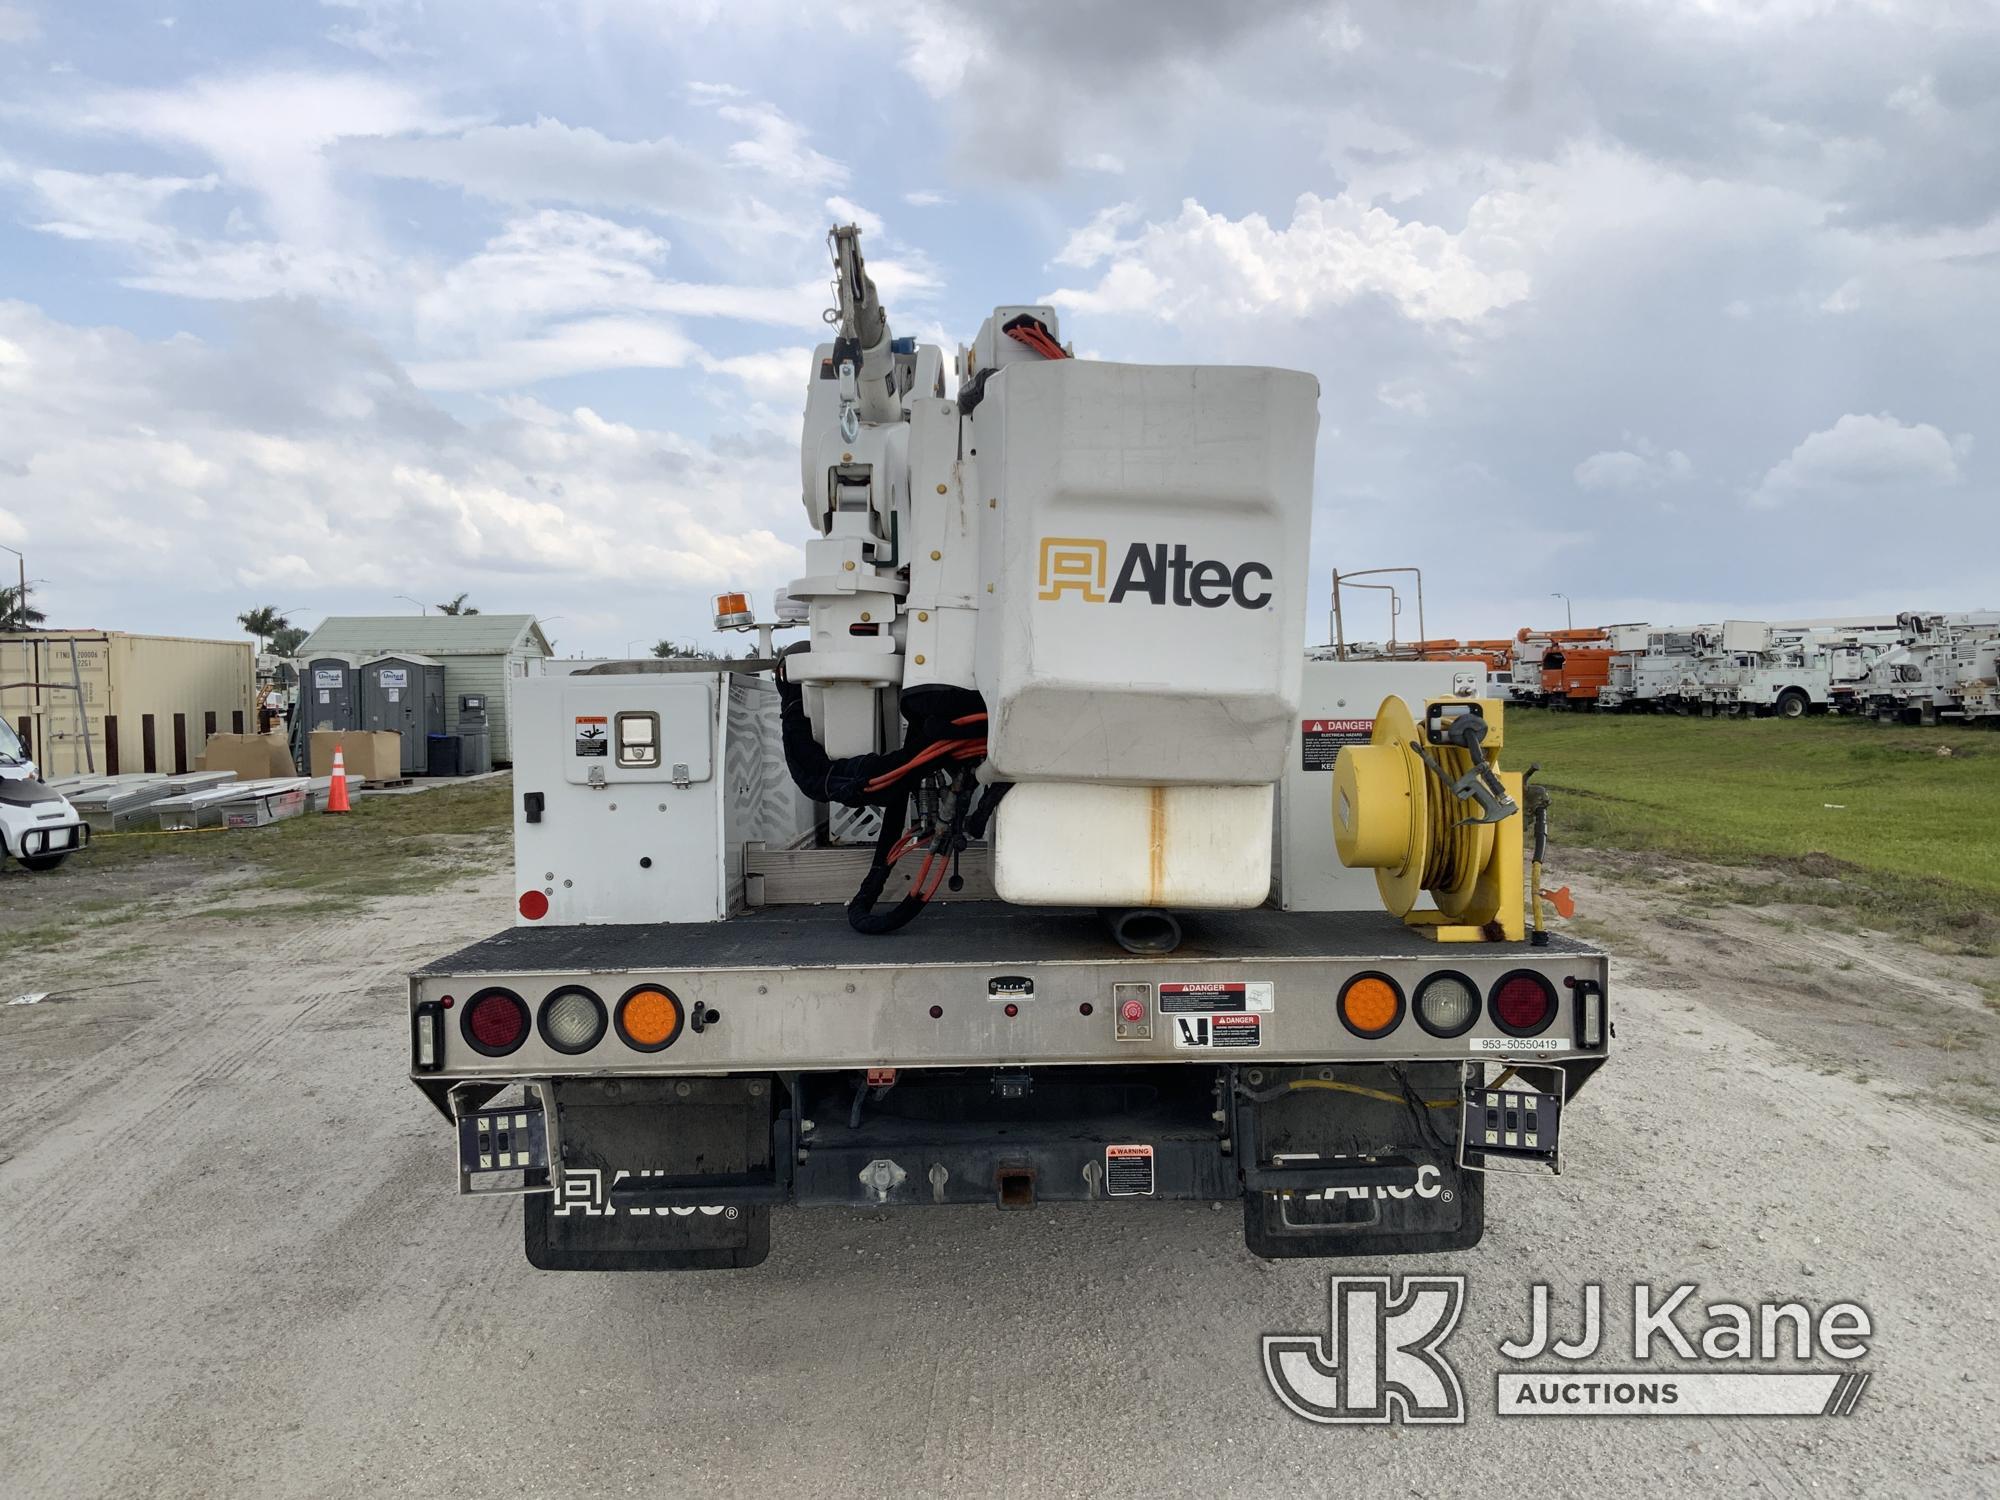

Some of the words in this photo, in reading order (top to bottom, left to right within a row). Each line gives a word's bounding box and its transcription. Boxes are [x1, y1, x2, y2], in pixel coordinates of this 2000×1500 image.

[1108, 542, 1273, 610] Altec
[1328, 721, 1373, 730] DANGER
[1482, 1039, 1557, 1049] 953-50550419
